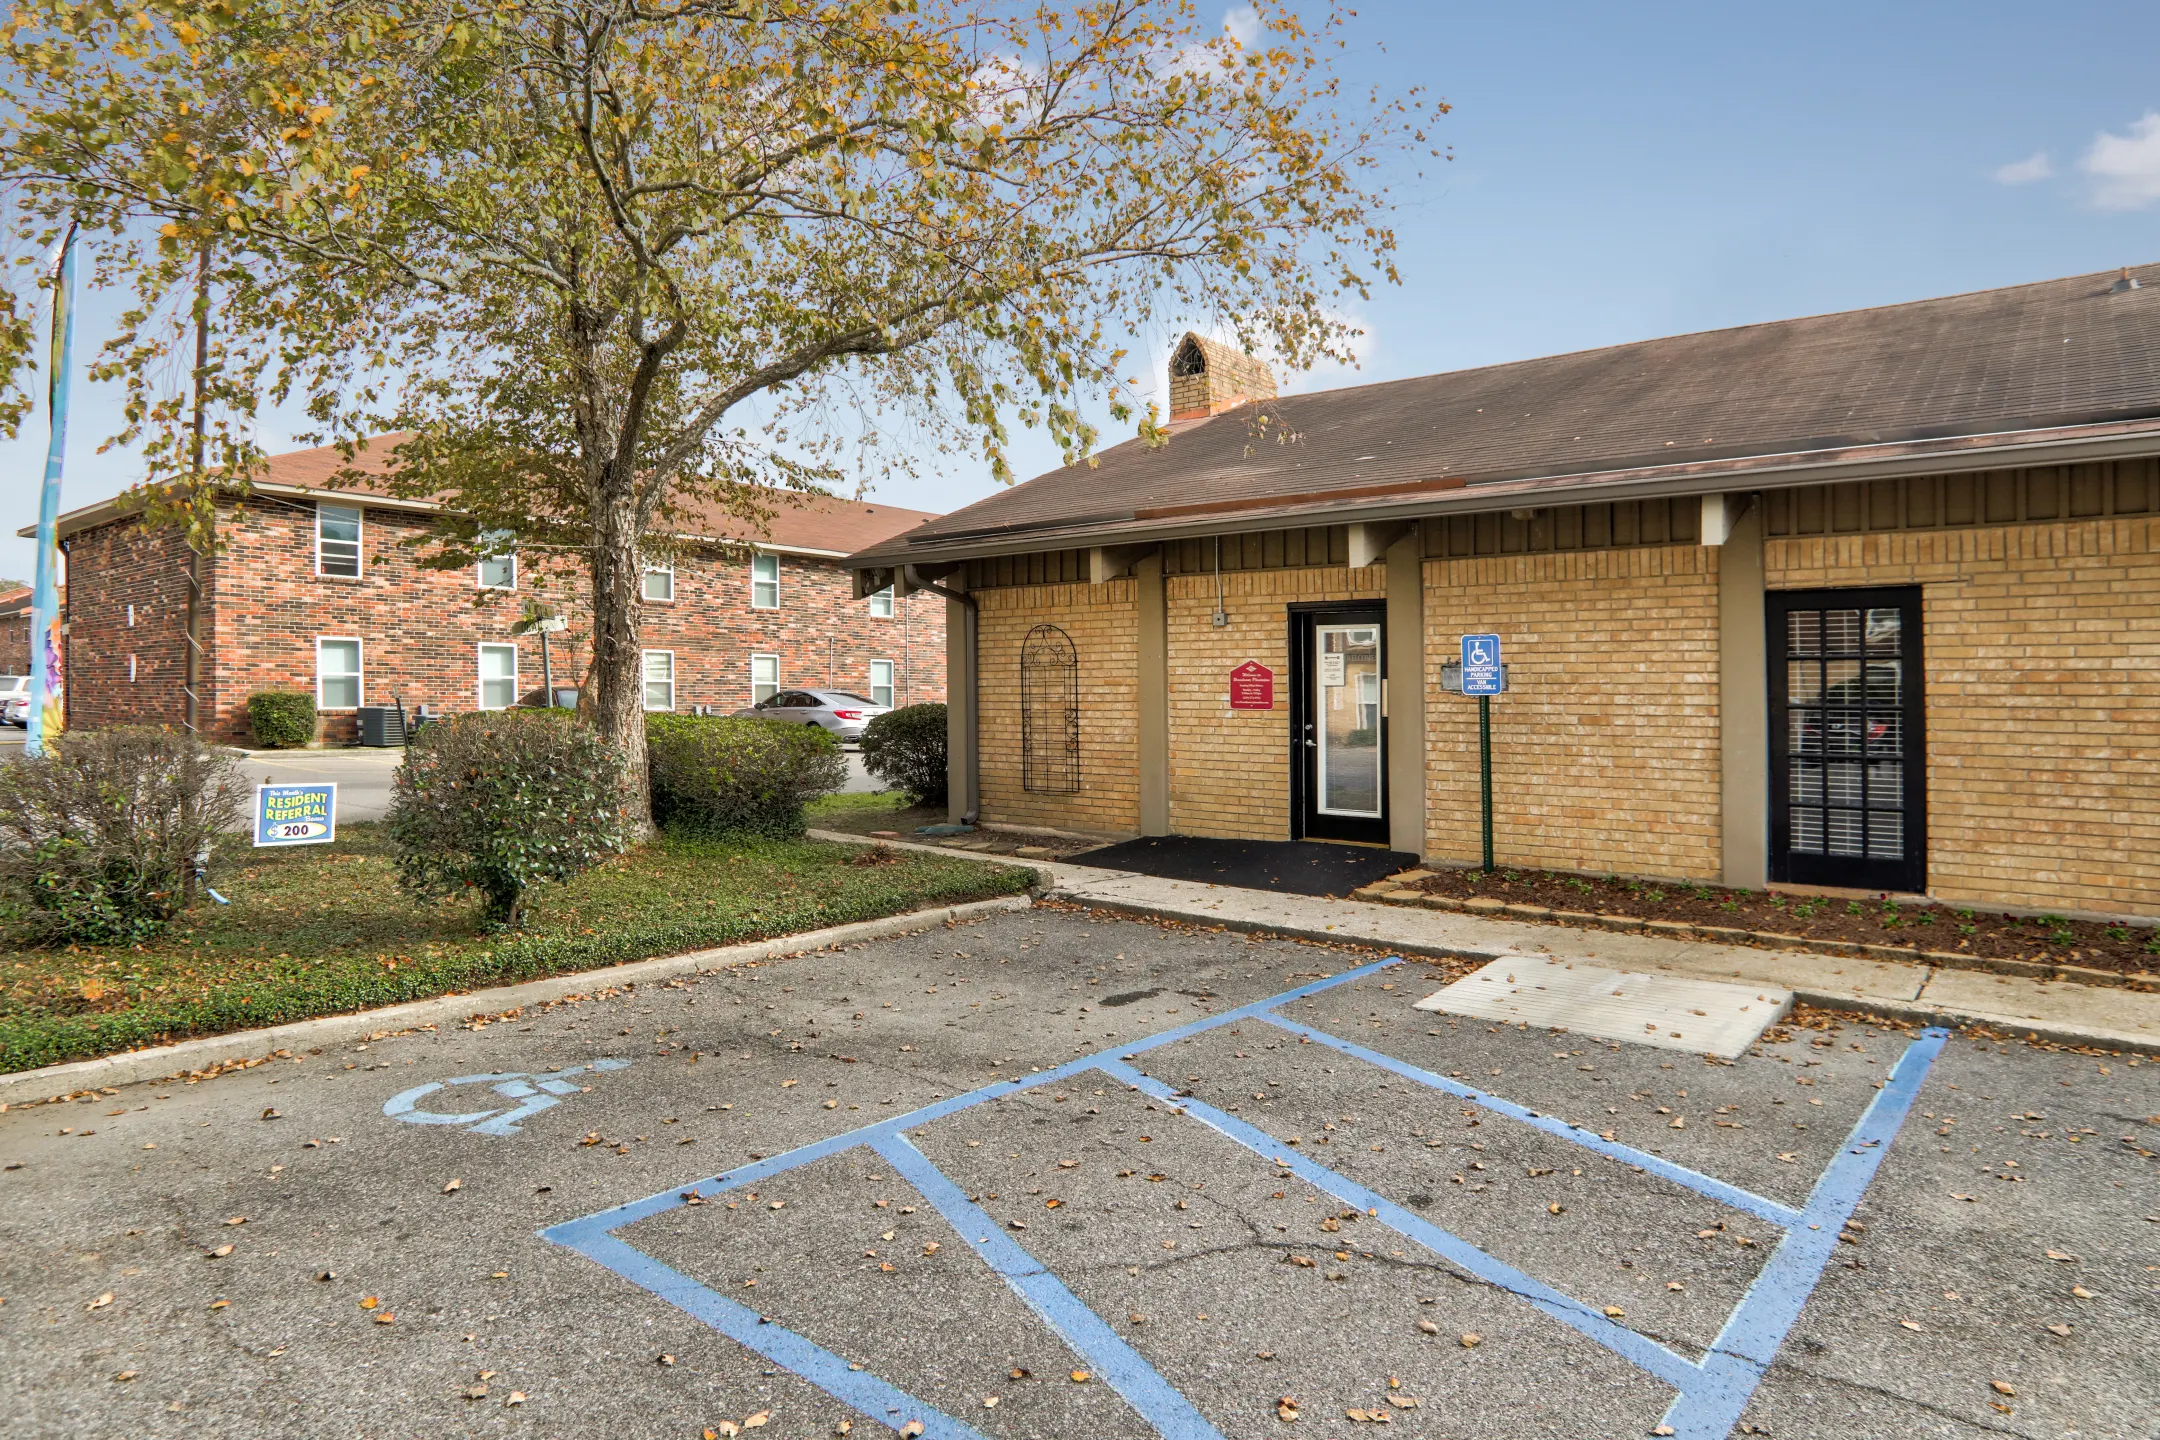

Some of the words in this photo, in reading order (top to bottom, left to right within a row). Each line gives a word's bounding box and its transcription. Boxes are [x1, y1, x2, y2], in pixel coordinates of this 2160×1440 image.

[267, 793, 328, 808] RESIDENT
[265, 804, 328, 821] REFERRAL
[284, 824, 309, 837] 200
